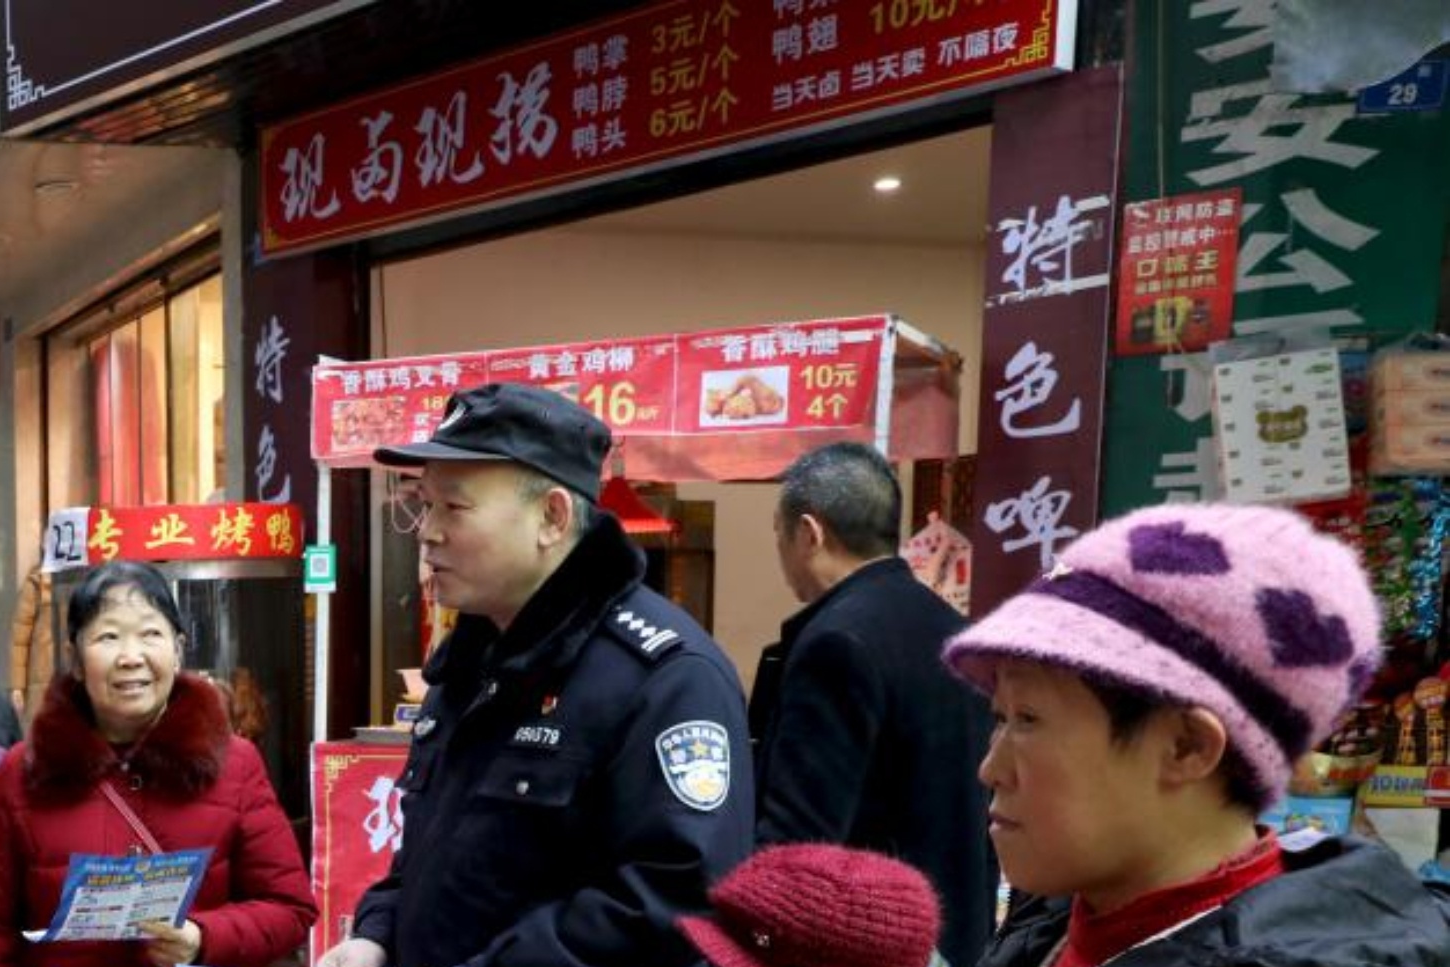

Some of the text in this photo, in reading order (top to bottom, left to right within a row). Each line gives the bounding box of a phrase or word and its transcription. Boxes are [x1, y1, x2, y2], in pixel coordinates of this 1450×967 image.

[650, 43, 740, 96] 5元/个
[1387, 82, 1419, 106] 29
[571, 87, 739, 159] 鸭头 6元/个
[800, 362, 858, 390] 10元
[255, 315, 291, 503] 特色
[583, 381, 636, 426] 16
[805, 394, 849, 420] 4个
[87, 508, 294, 561] 专业烤鸭
